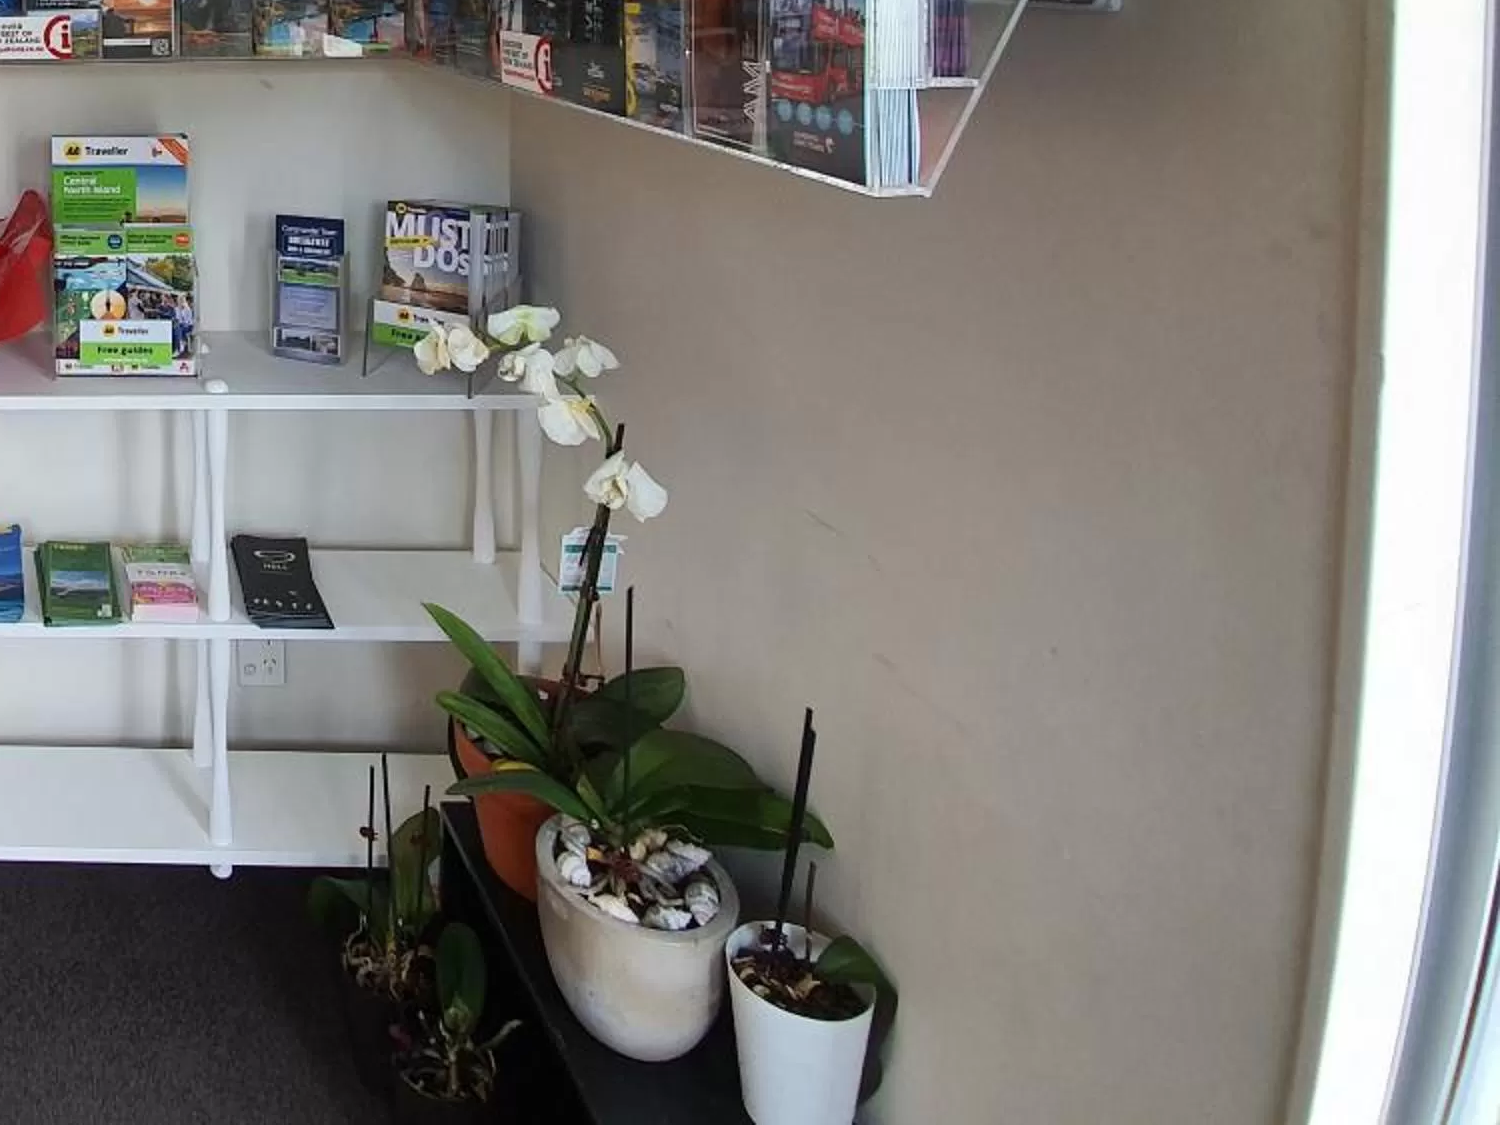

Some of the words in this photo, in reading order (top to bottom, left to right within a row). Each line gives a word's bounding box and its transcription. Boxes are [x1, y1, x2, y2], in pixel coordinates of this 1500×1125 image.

[85, 145, 130, 158] Traveller
[63, 176, 98, 187] Central
[387, 211, 471, 251] MUST
[391, 328, 413, 341] Free
[96, 345, 117, 354] Free
[121, 345, 154, 356] guides
